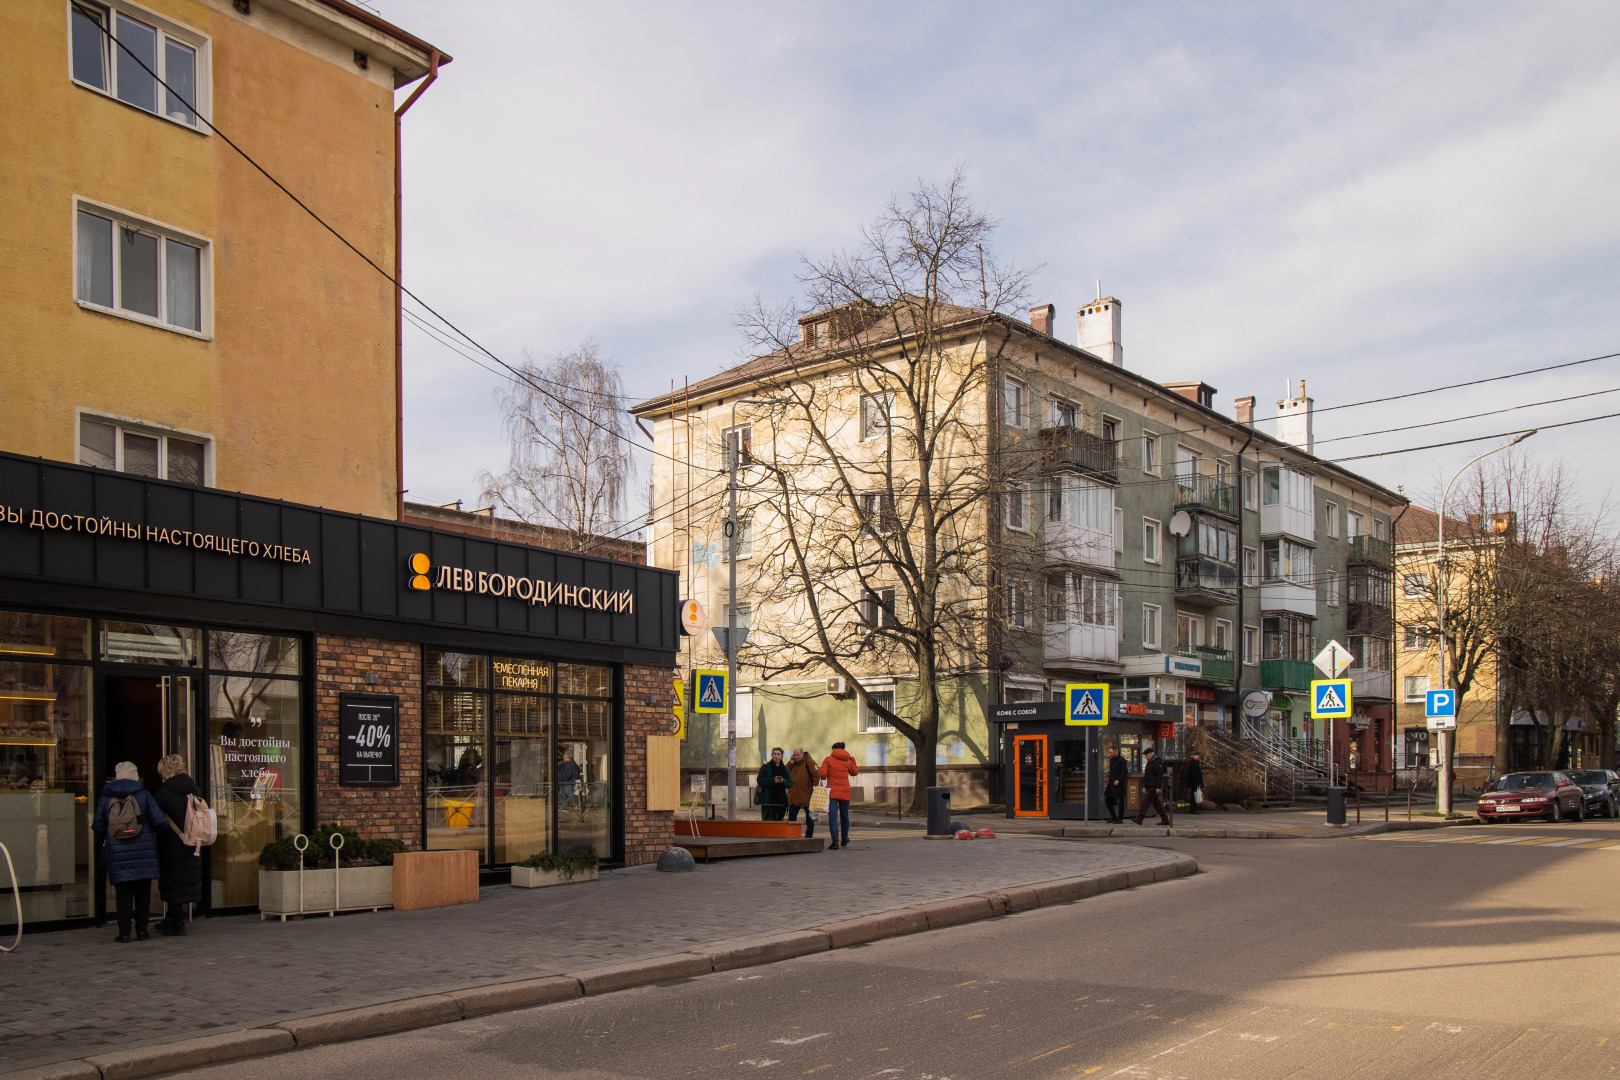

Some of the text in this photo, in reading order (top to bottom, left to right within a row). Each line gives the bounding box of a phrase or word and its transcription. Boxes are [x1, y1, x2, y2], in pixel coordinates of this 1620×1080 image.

[30, 509, 141, 540] ДОСТОЙНЫ
[146, 526, 259, 556] НАСТОЯЩЕГО
[263, 544, 312, 565] ХЛЕБА
[436, 565, 633, 614] ЛЕВ БОРОДИНСКИЙ
[502, 676, 538, 689] ПЕКАРНЯ
[220, 735, 290, 749] Вы достойны
[347, 724, 391, 748] -40%
[224, 753, 287, 764] настоящего
[240, 767, 270, 778] хлеба
